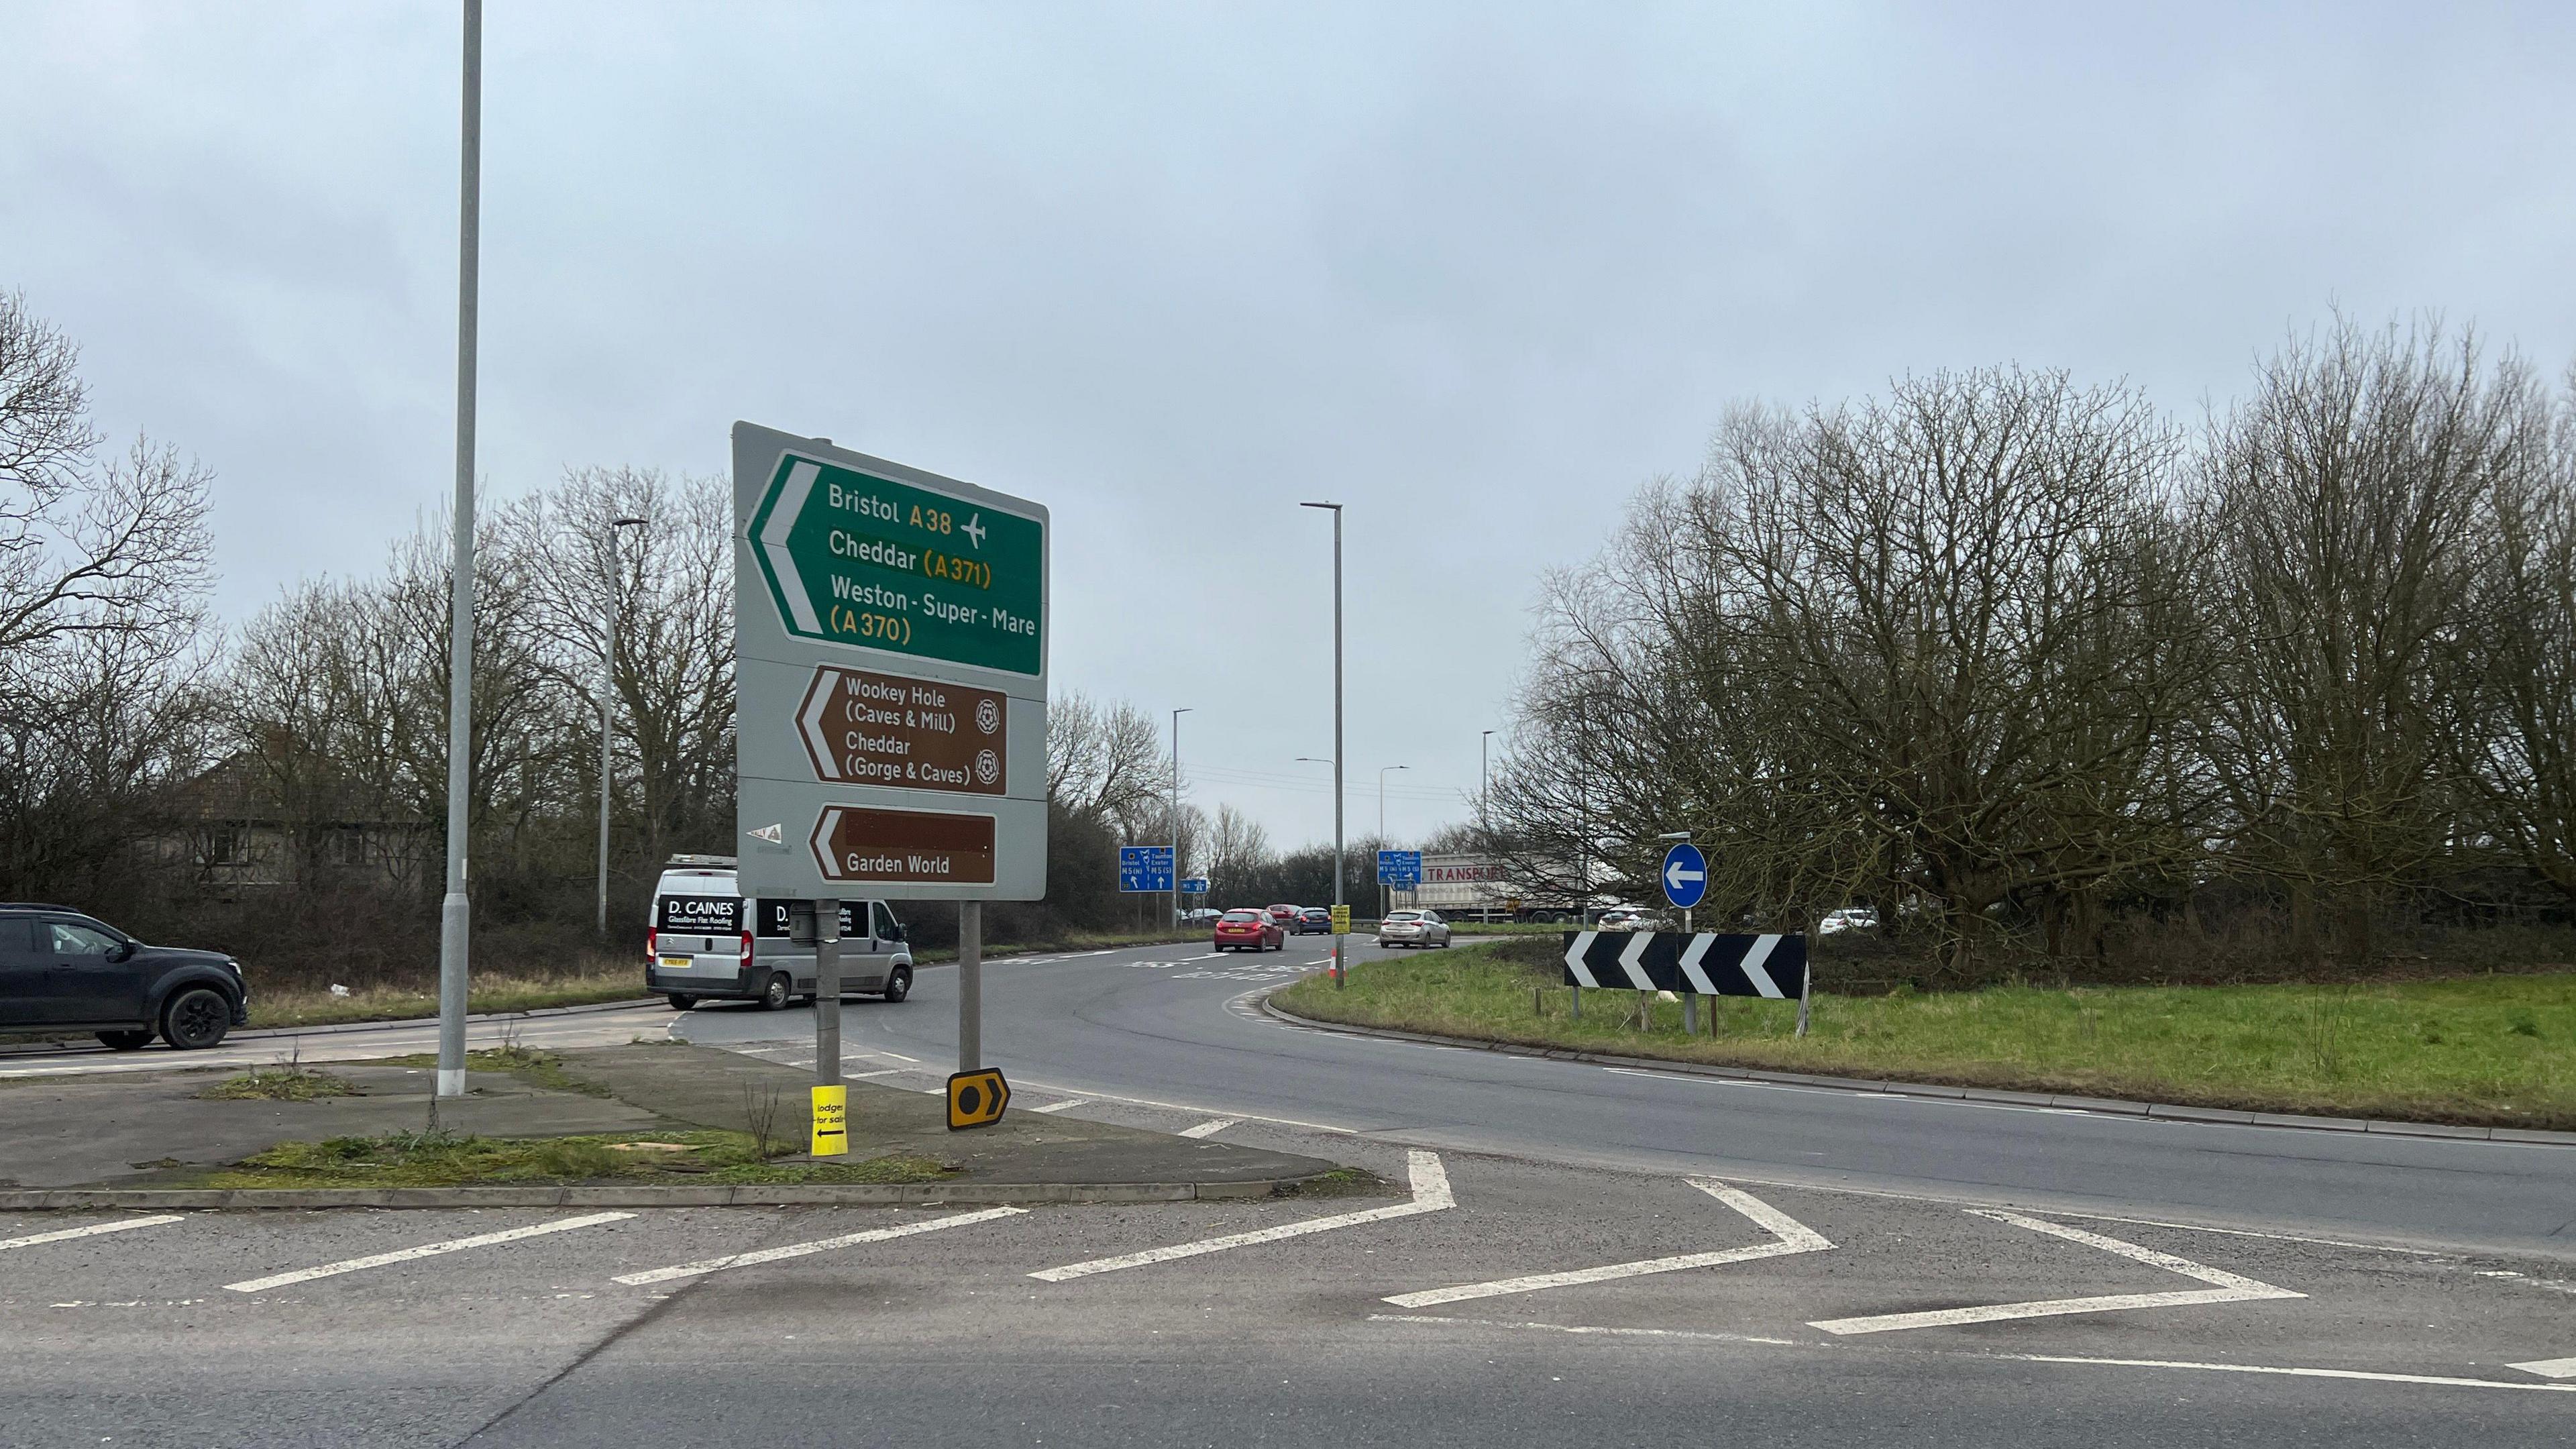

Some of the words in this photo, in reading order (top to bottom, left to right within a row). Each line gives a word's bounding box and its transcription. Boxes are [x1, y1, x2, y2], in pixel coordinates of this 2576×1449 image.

[829, 483, 900, 523] Bristol
[909, 505, 952, 536] A38
[829, 530, 917, 571] Cheddar
[924, 549, 991, 590] (A371)
[830, 604, 912, 646] (A370)
[846, 677, 906, 705] Wookey
[912, 687, 945, 708] Hole
[846, 700, 900, 727] (Caves
[906, 710, 916, 727] &
[921, 711, 956, 735] Mill)
[846, 731, 911, 755] Cheddar
[846, 754, 902, 782] (Gorge
[906, 762, 917, 780] &
[921, 763, 971, 786] Caves)
[847, 853, 902, 873] Garden
[908, 855, 950, 874] World
[1428, 865, 1506, 881] TRANSPORT
[669, 901, 682, 914] D.
[685, 902, 734, 916] CAINES
[709, 917, 733, 926] Roofing
[776, 906, 788, 922] D.
